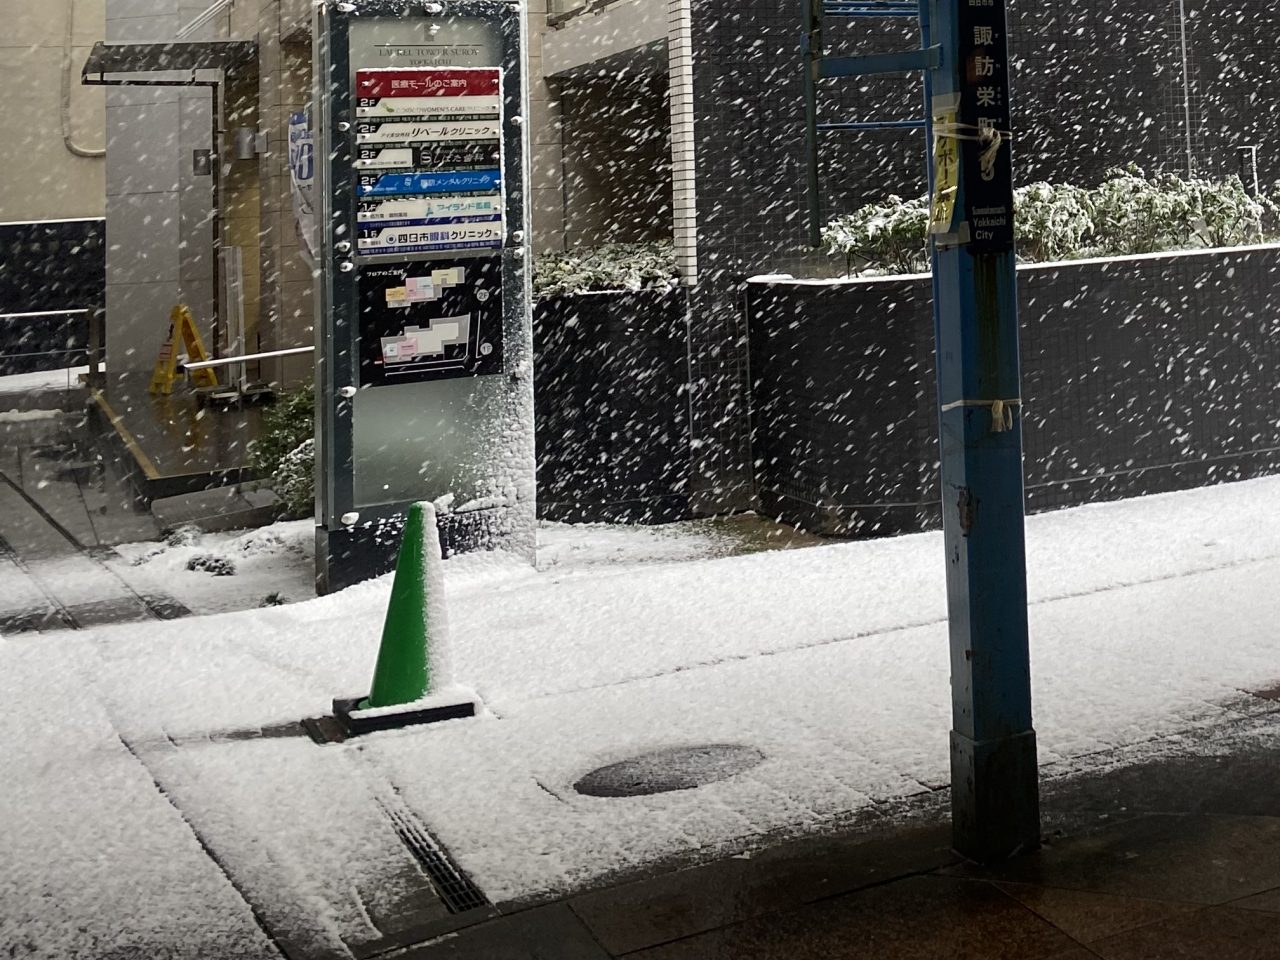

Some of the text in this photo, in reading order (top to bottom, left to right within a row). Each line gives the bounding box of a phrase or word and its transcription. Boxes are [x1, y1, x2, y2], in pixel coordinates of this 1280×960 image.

[417, 48, 450, 57] TOWER
[360, 98, 376, 107] 2F
[361, 124, 376, 133] 2F
[411, 126, 490, 138] リベールクリニック
[361, 150, 376, 159] 2F
[361, 176, 377, 185] 2F
[362, 203, 377, 212] 1F
[973, 216, 1006, 227] Yokkaichi
[398, 229, 492, 243] 四日市眼科クリニック
[975, 230, 994, 240] City
